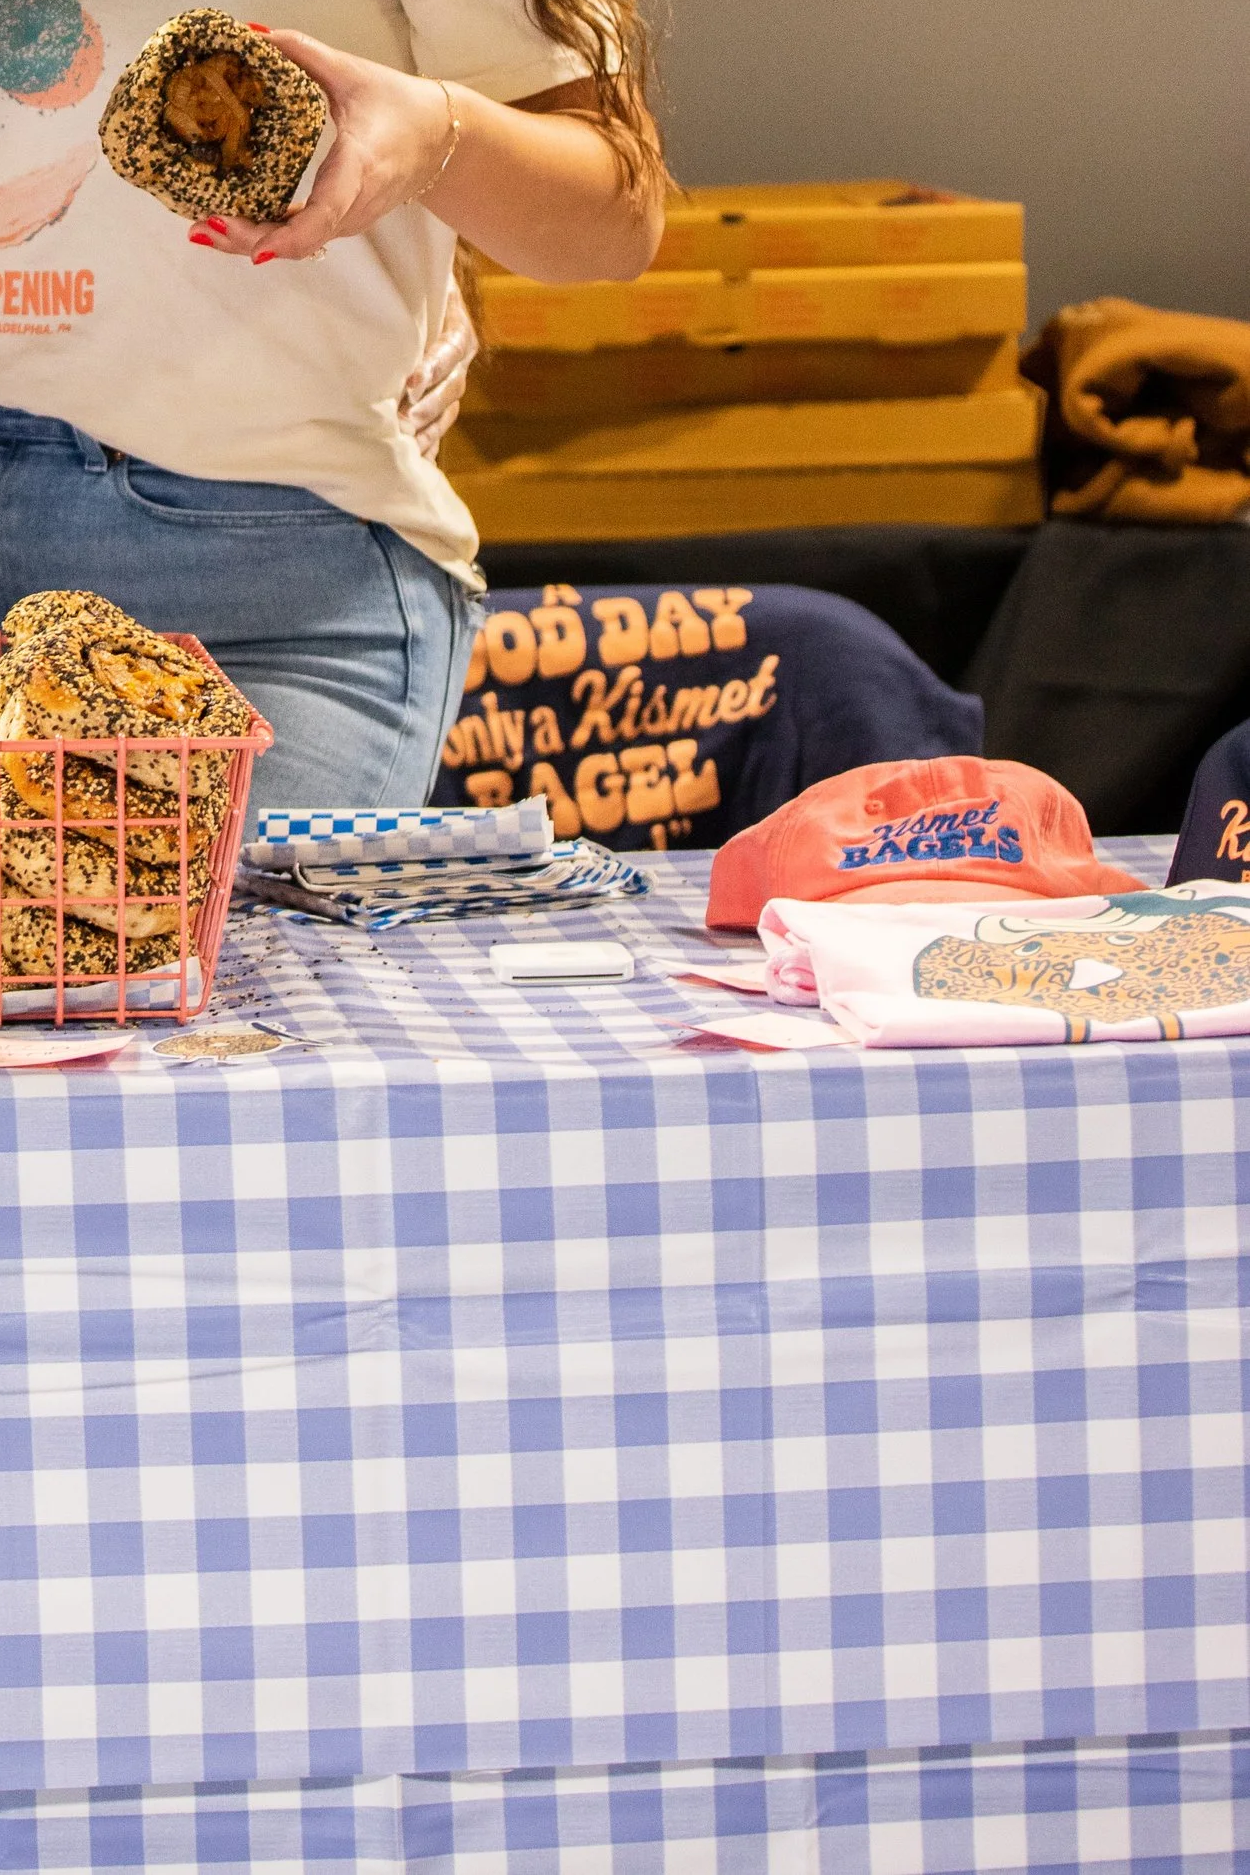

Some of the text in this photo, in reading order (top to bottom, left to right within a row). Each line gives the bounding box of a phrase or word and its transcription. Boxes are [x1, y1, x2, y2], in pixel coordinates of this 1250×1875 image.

[592, 587, 754, 668] DAY
[530, 704, 565, 757] a
[569, 654, 781, 750] Kismet
[838, 827, 1023, 870] BAGELS
